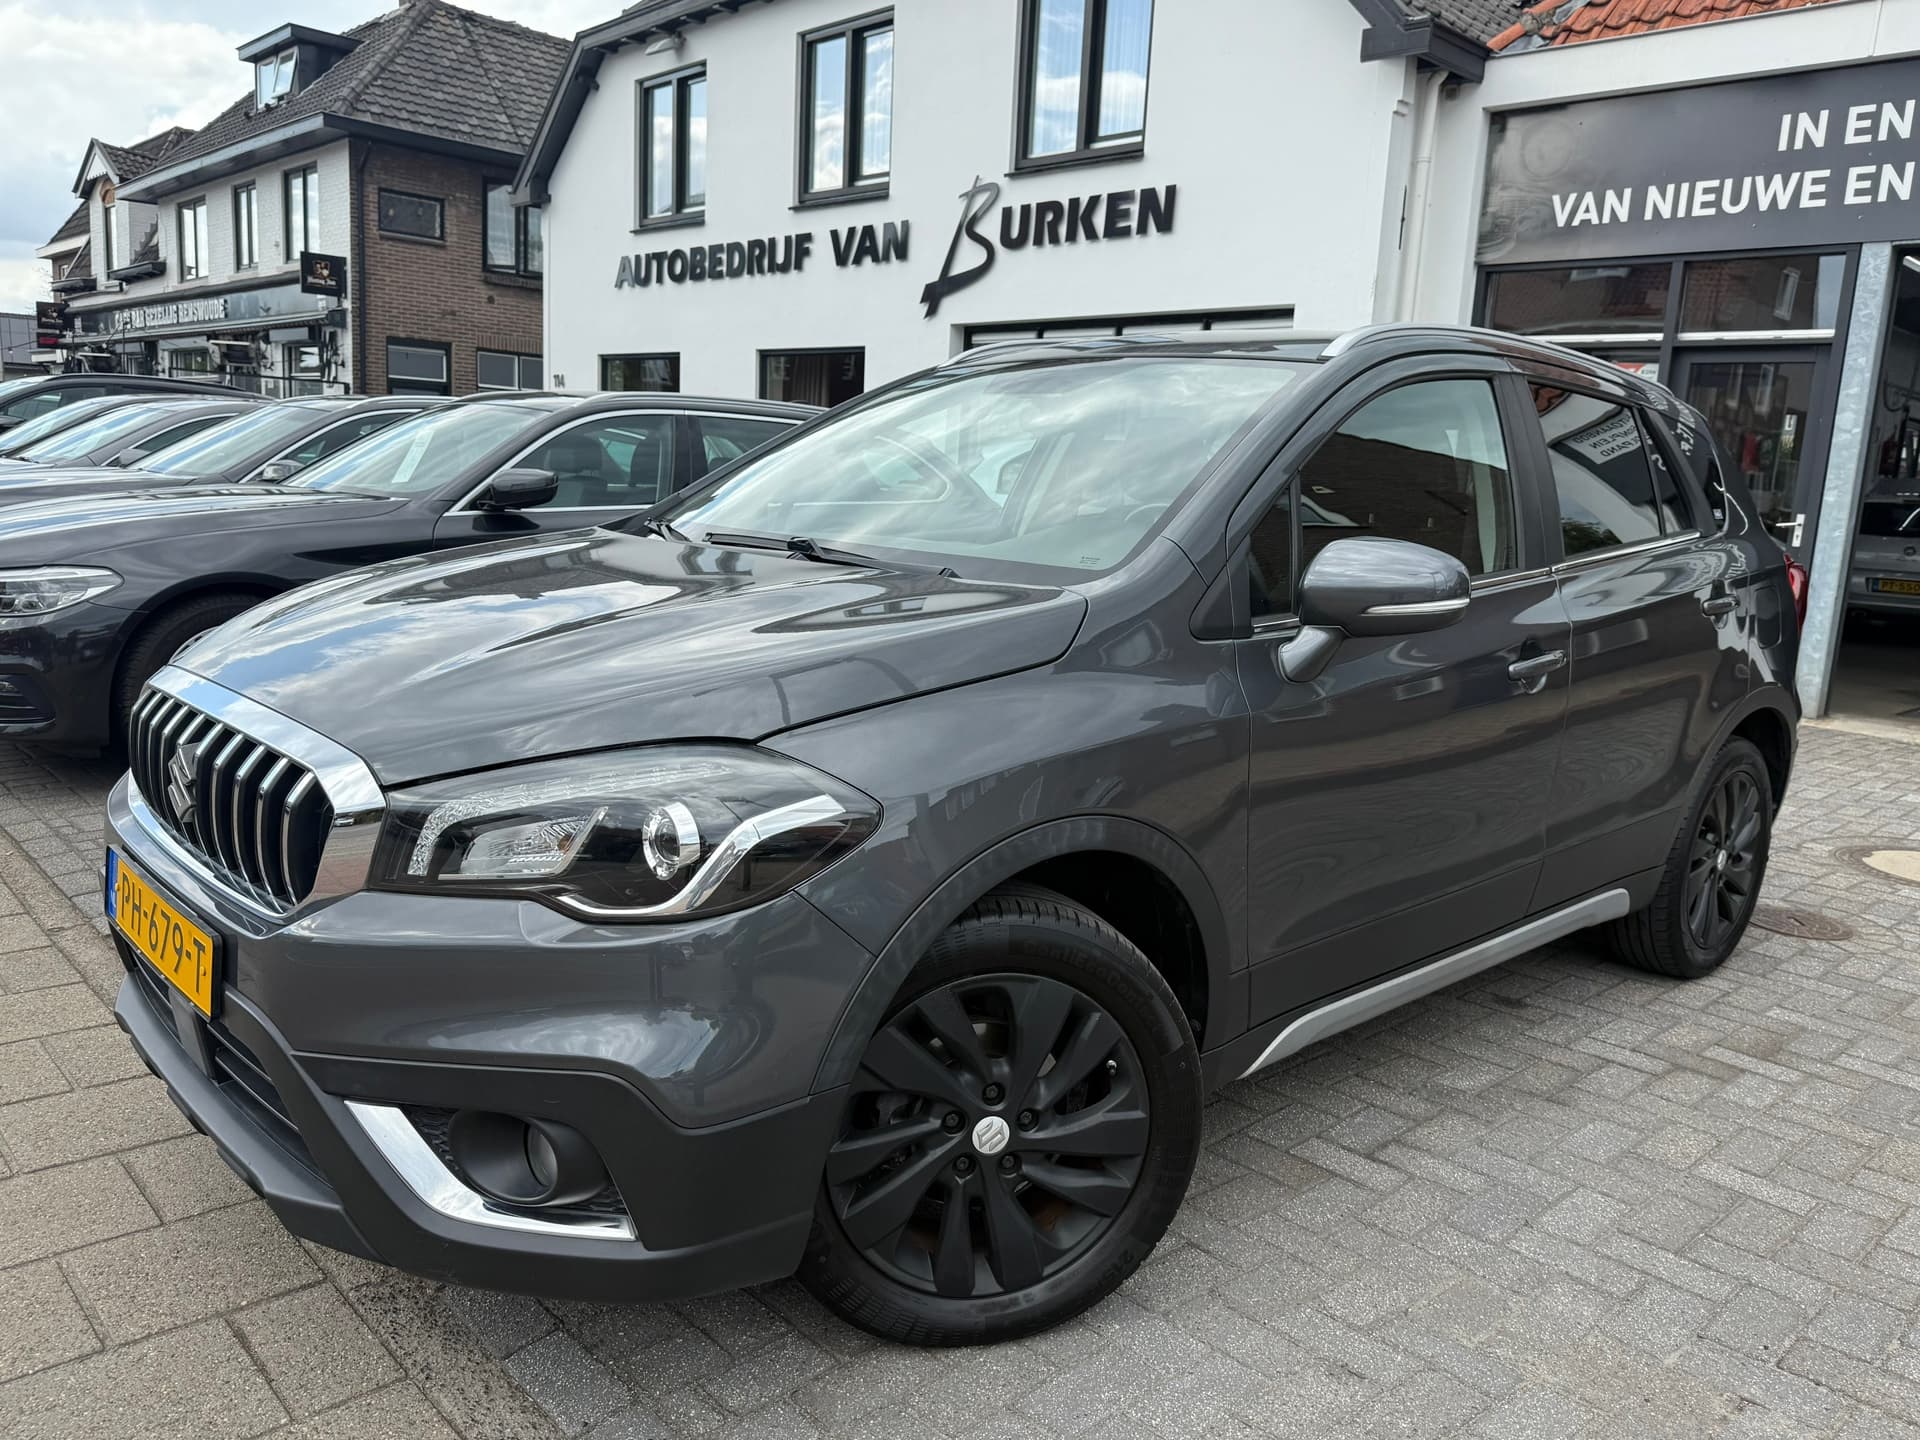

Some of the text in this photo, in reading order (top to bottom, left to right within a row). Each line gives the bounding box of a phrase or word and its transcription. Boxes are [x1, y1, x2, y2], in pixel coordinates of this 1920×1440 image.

[1777, 99, 1917, 152] IN EN
[1551, 161, 1917, 228] VAN NIEUWE EN
[614, 174, 1177, 319] AUTOBEDRIJF VAN BURKEN
[120, 871, 206, 994] PH-679-T
